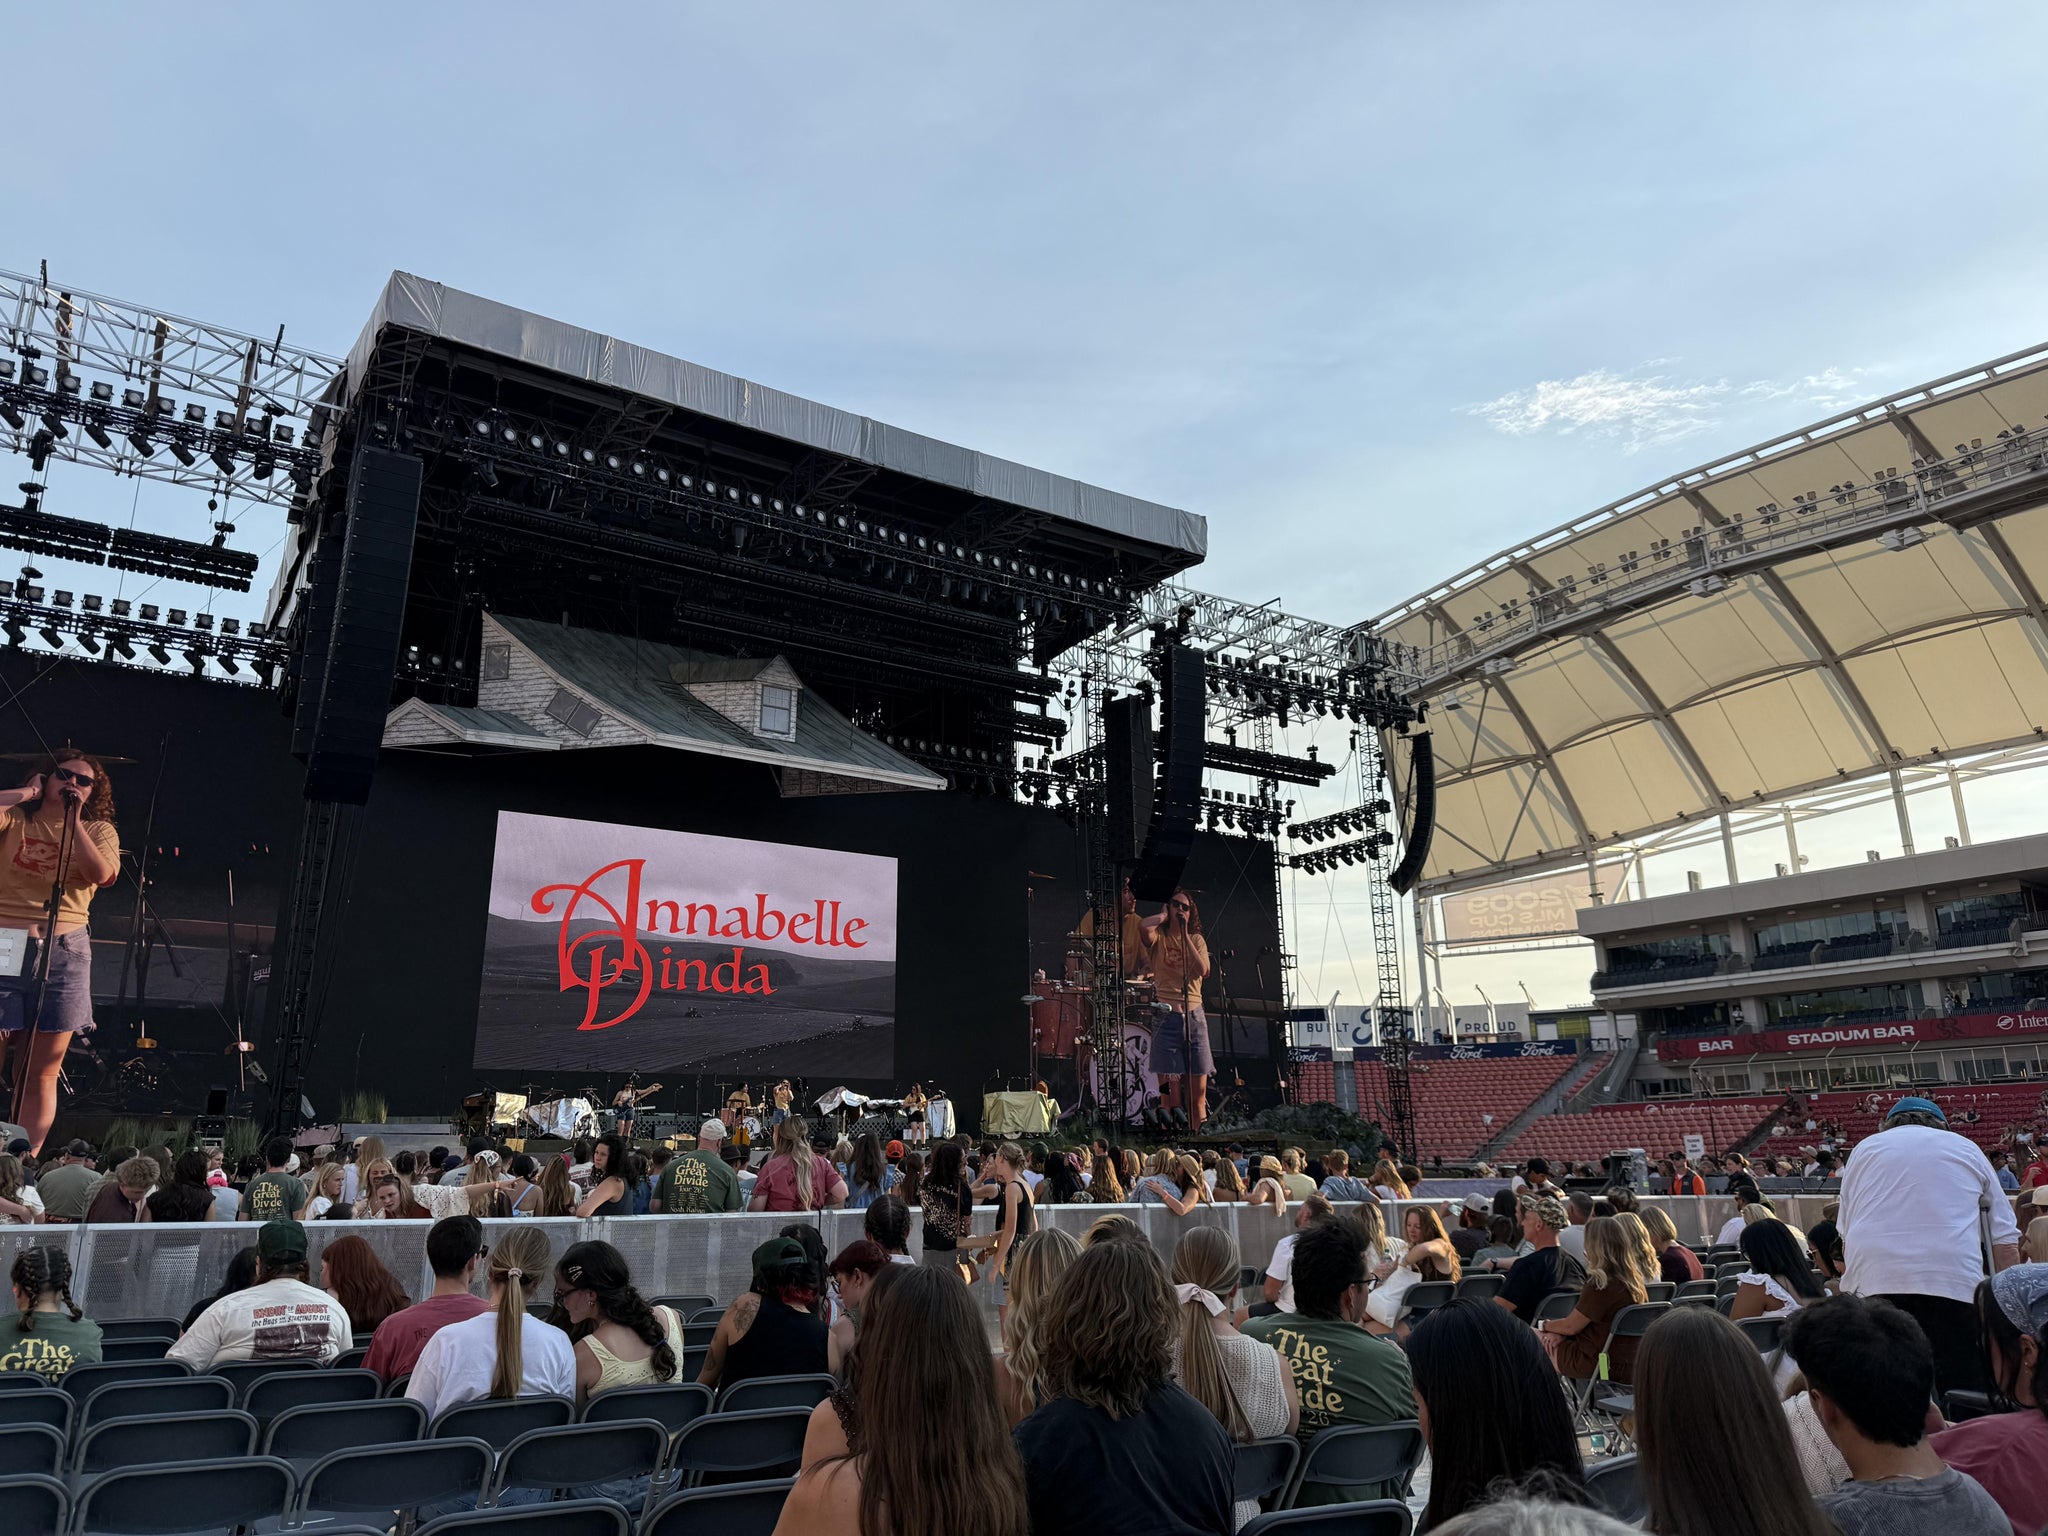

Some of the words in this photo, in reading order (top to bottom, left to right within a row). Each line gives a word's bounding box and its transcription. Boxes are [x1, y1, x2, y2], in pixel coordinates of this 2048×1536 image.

[531, 859, 869, 992] Annabelle
[566, 930, 778, 1031] Dinda
[1788, 1027, 1870, 1045] STADIUM
[1873, 1025, 1915, 1039] BAR
[1450, 1045, 1483, 1060] Ford
[1520, 1041, 1556, 1056] Ford
[1698, 1040, 1734, 1052] BAR
[675, 1165, 708, 1177] Great
[684, 1158, 706, 1170] The
[260, 1182, 279, 1192] The
[674, 1174, 709, 1187] Divide
[253, 1189, 281, 1199] Great
[253, 1198, 283, 1209] Divde
[295, 1304, 329, 1314] AUGUST
[19, 1338, 71, 1359] The
[1274, 1327, 1329, 1364] The
[1286, 1357, 1334, 1386] eat
[1296, 1379, 1345, 1413] ide
